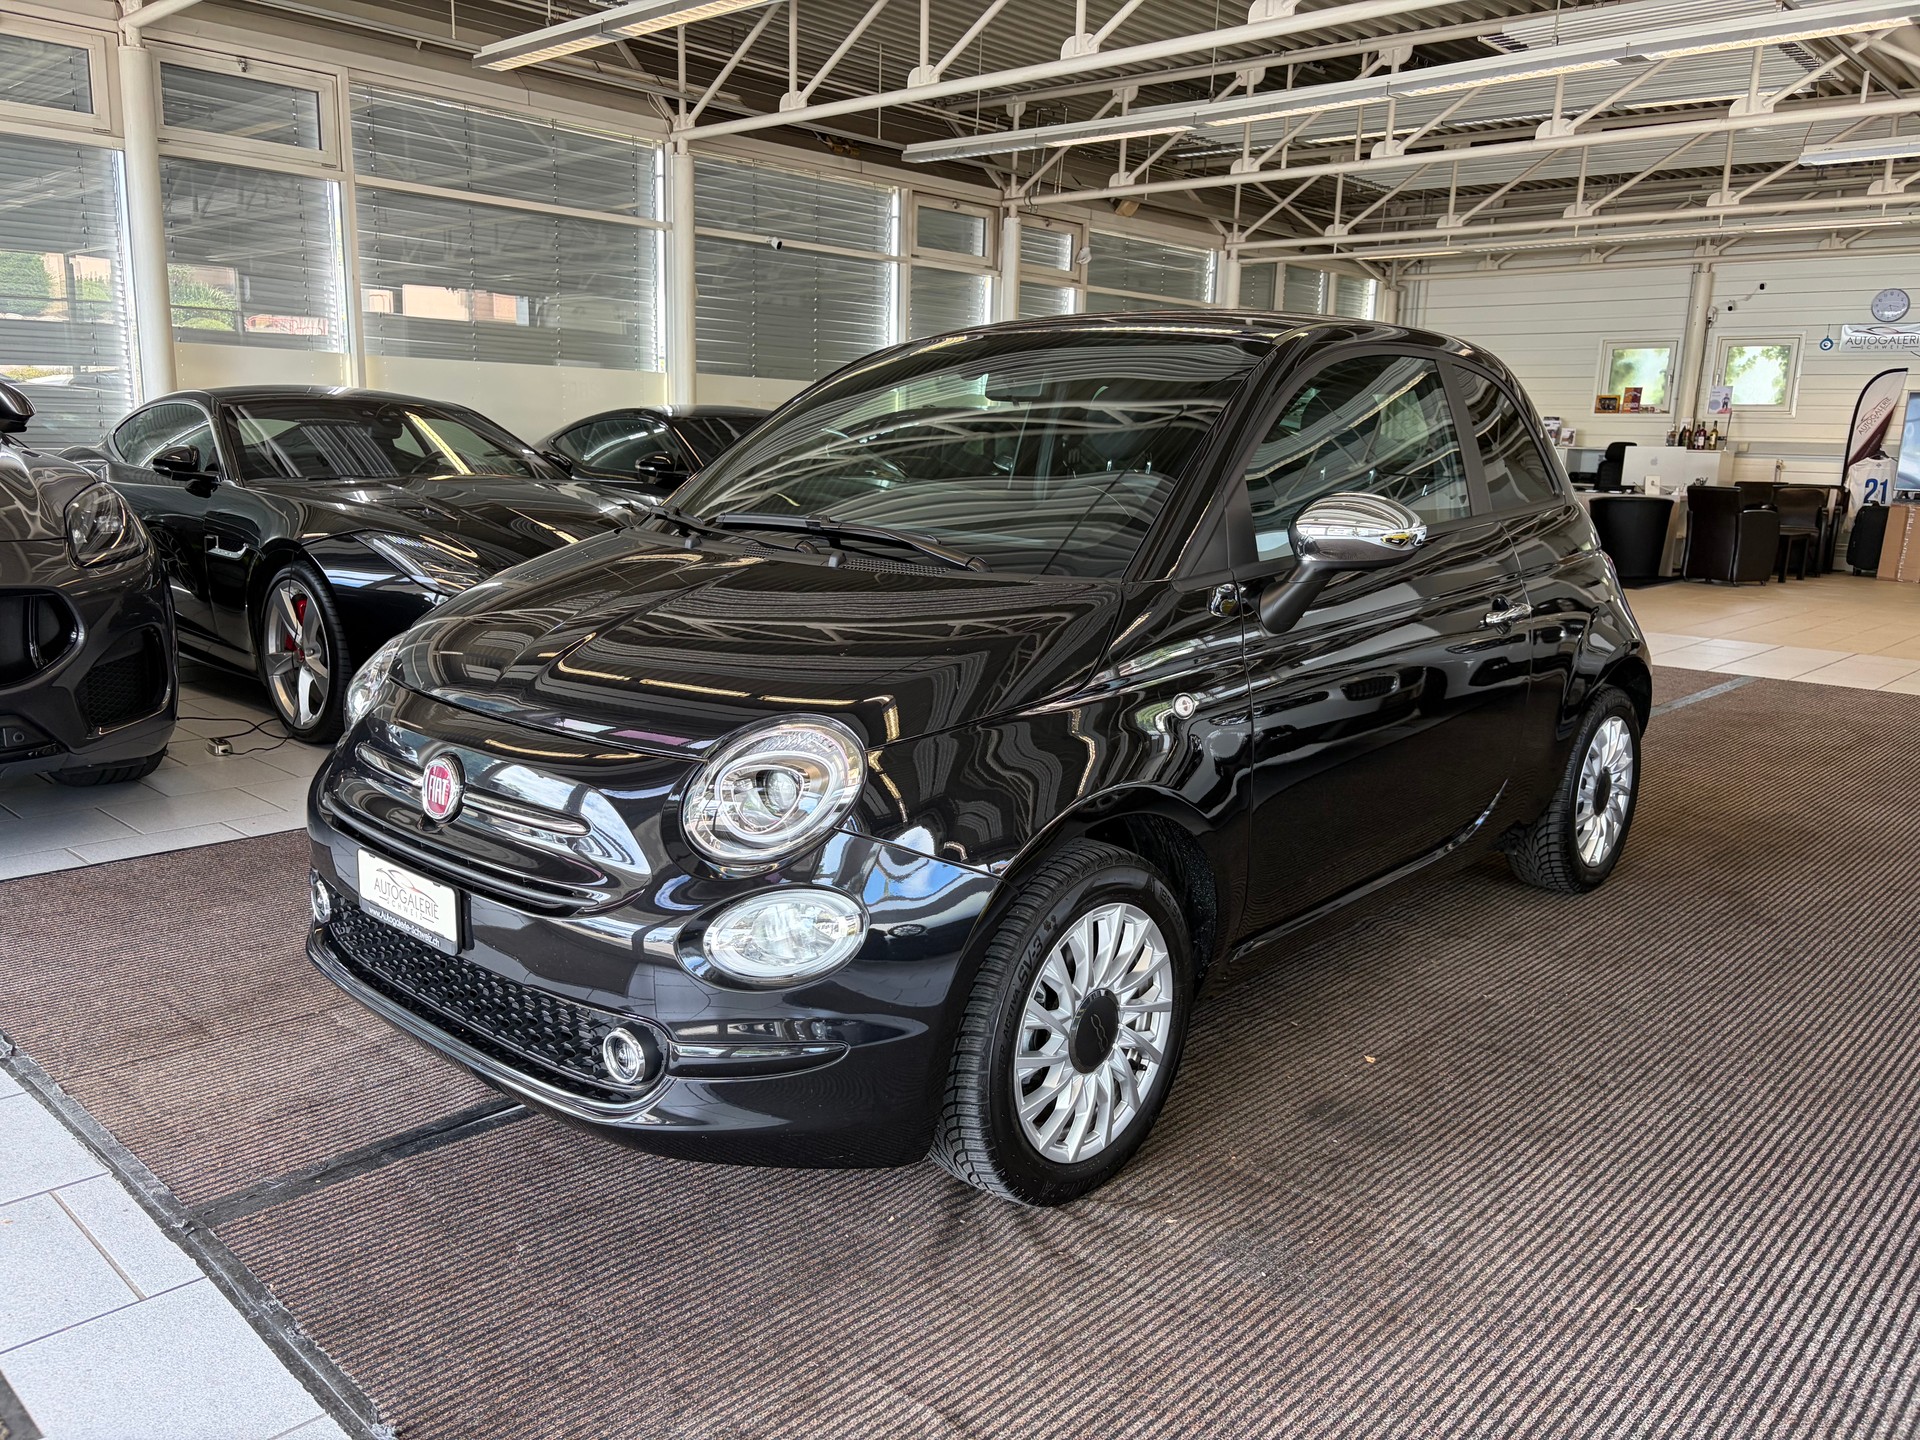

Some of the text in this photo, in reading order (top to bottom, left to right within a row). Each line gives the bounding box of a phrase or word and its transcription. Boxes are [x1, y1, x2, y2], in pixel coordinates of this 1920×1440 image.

[1858, 397, 1891, 436] AUTOGALERIE
[1863, 478, 1888, 504] 21
[428, 775, 448, 806] FIAT
[374, 877, 440, 920] AUTOGALERIE
[386, 897, 423, 921] SCHWEIZ
[1018, 935, 1043, 988] SV-3
